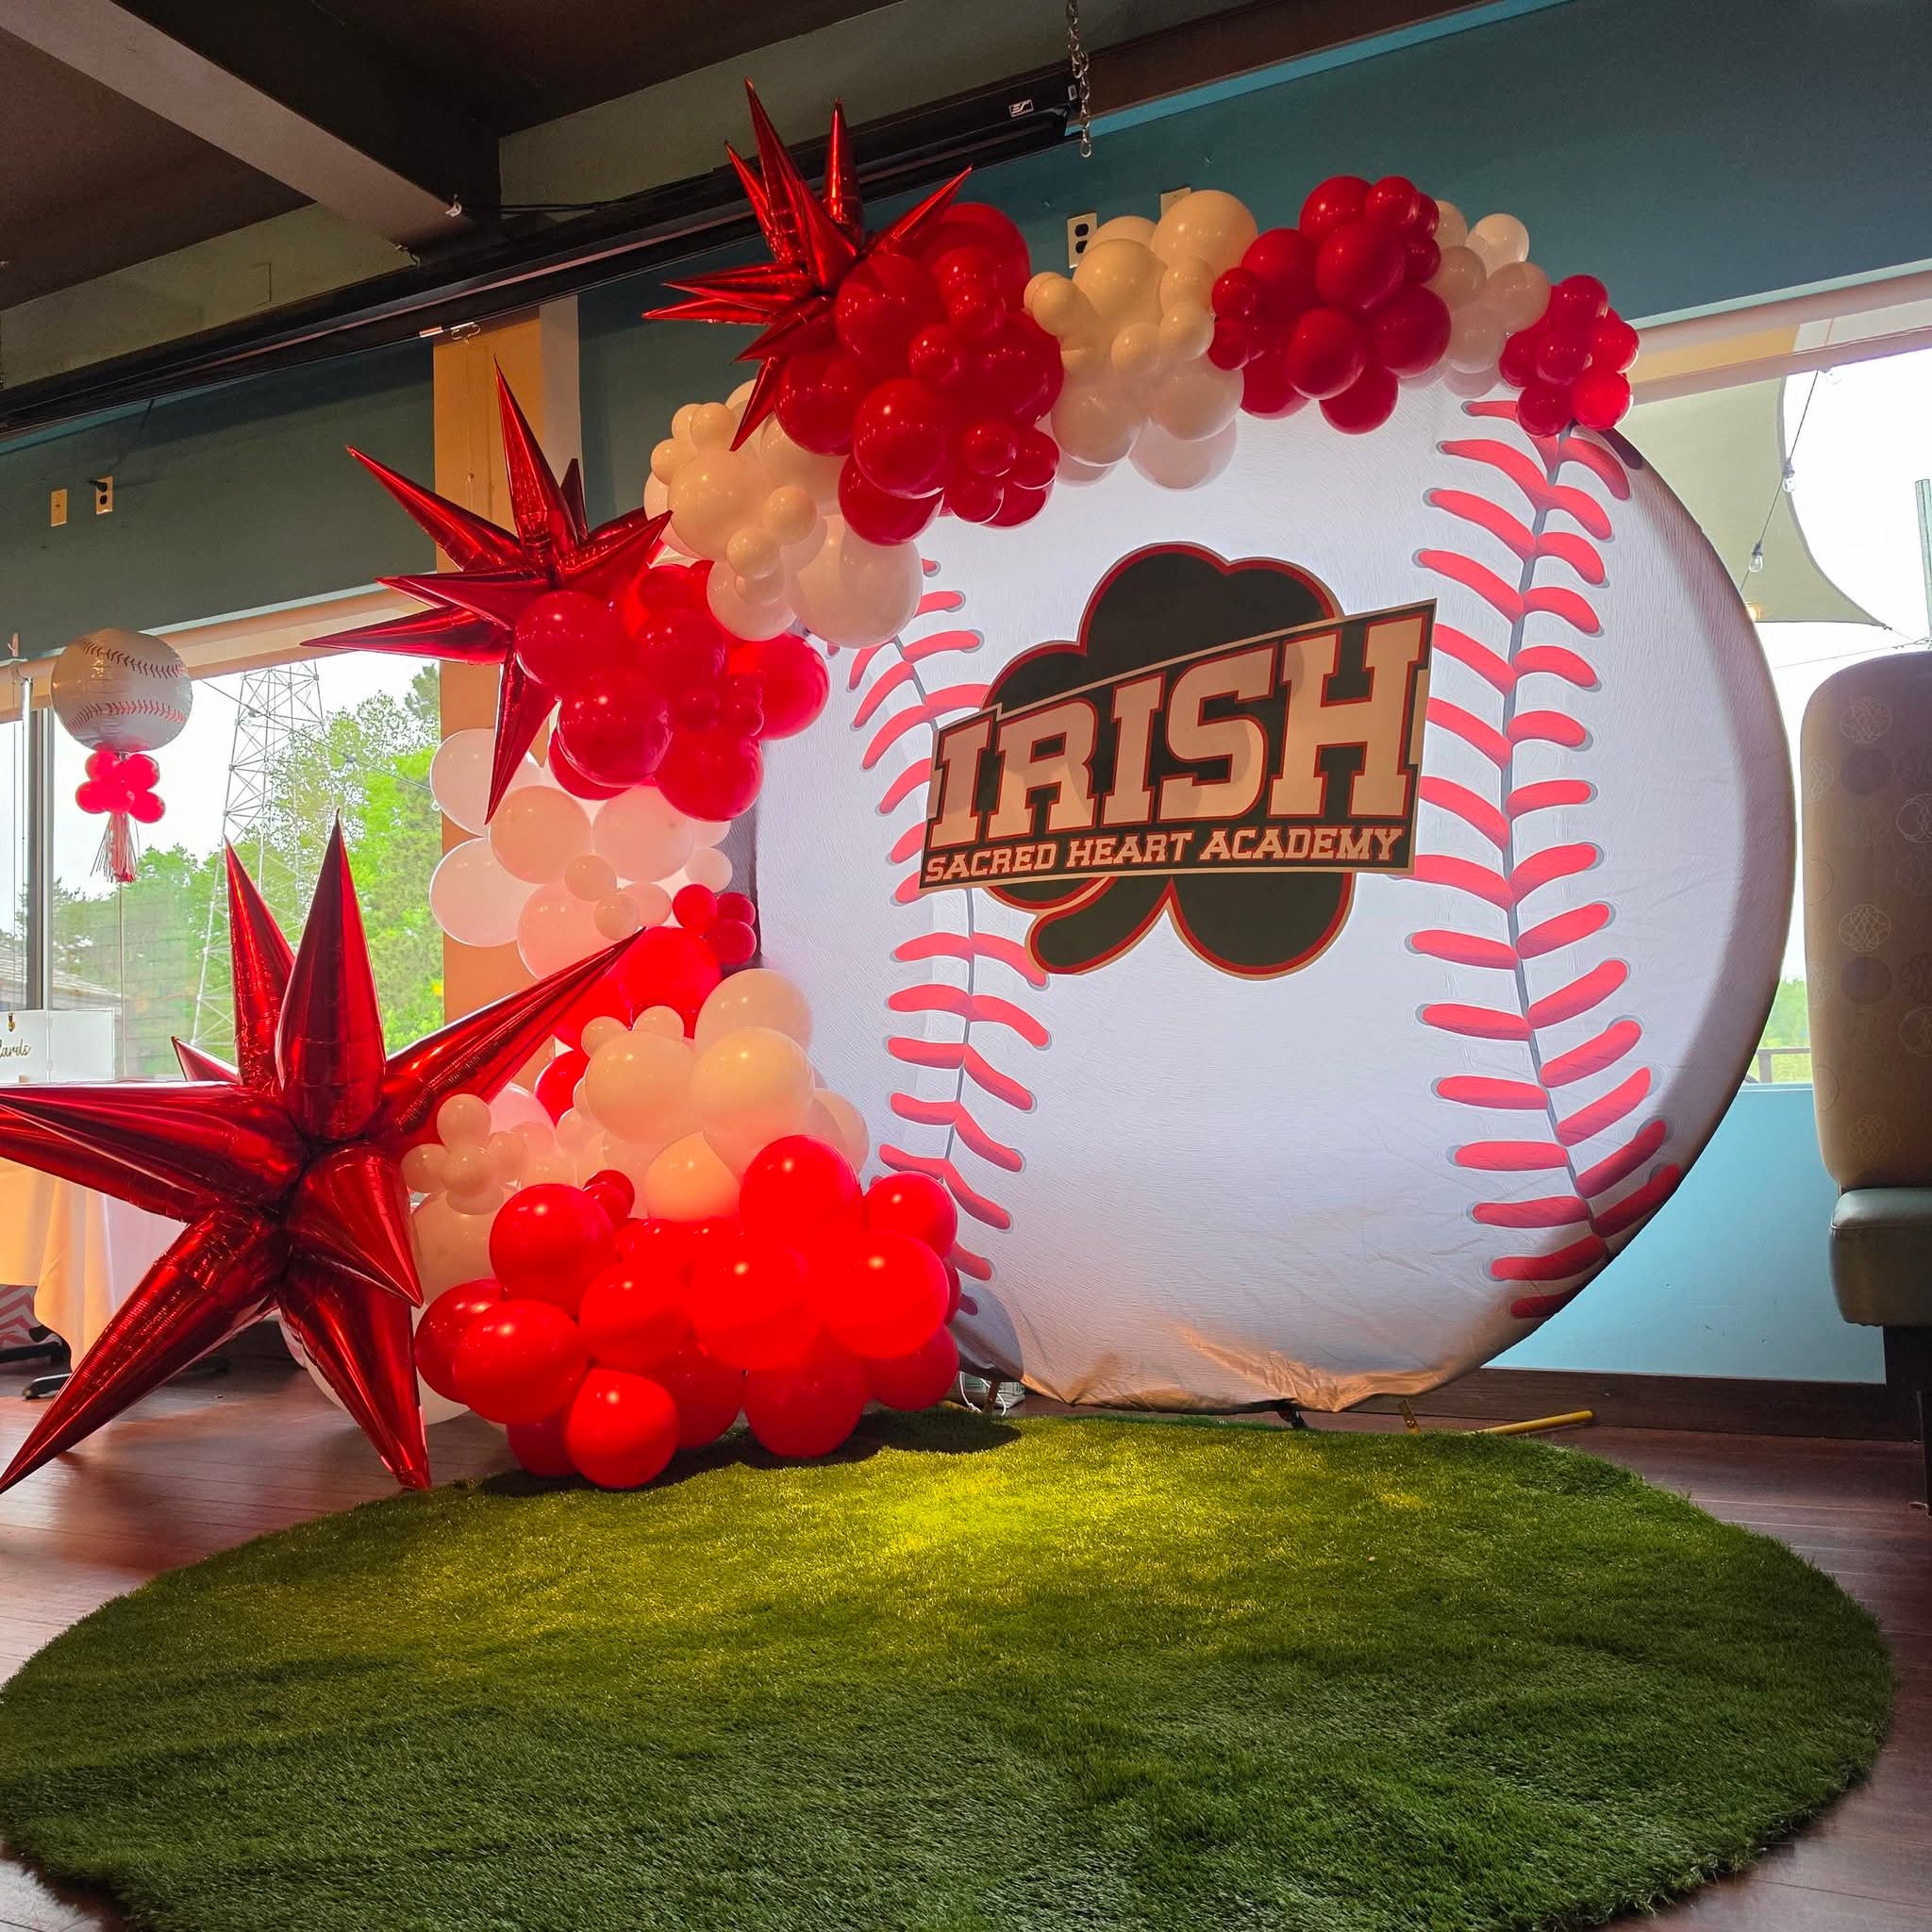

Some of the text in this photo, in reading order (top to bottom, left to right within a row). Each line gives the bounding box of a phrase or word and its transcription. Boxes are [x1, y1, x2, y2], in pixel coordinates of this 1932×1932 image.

[929, 614, 1425, 848] IRISH
[925, 826, 1404, 882] SACRED HEART ACADEMY
